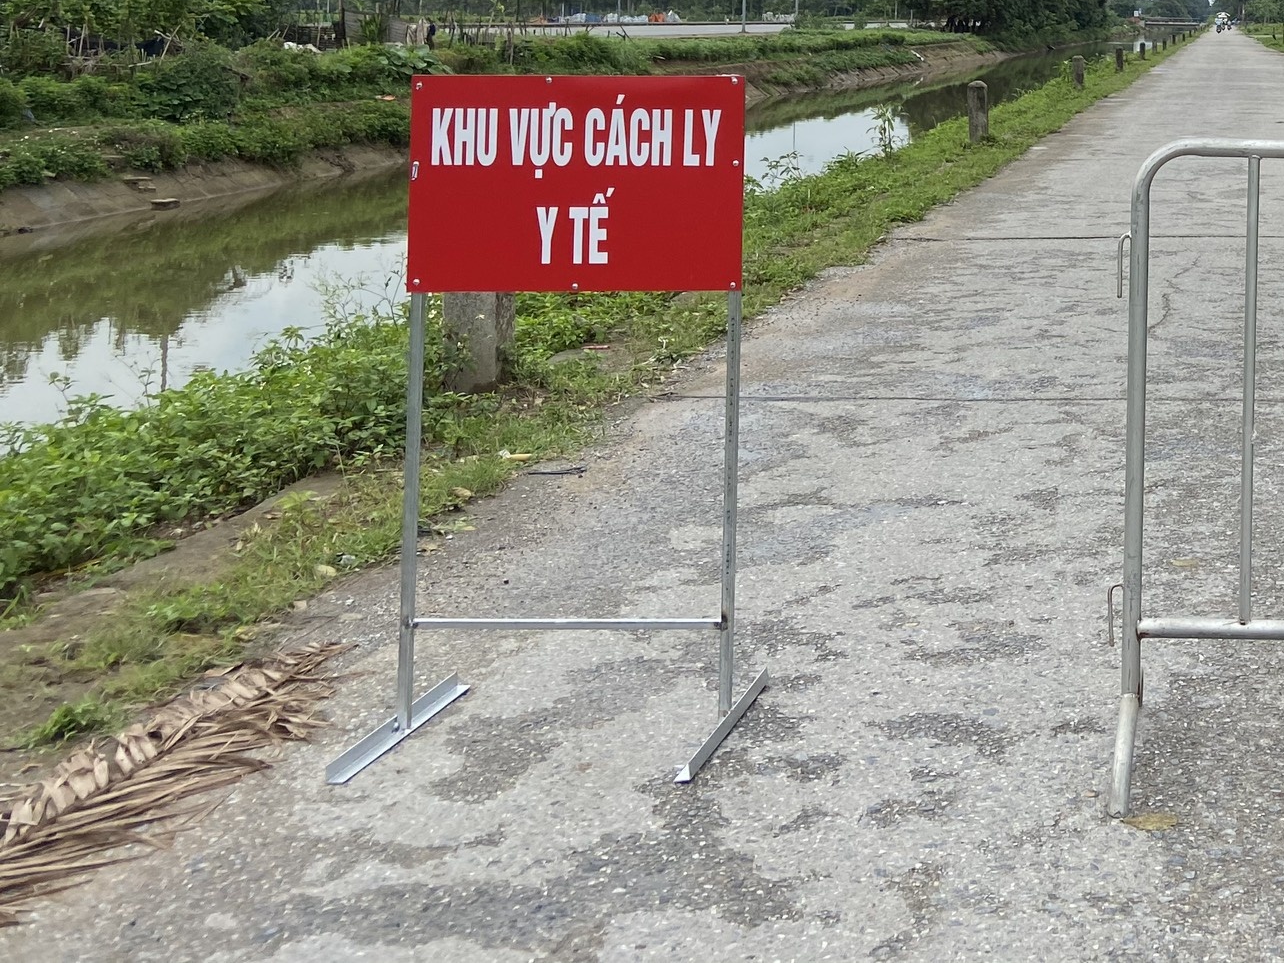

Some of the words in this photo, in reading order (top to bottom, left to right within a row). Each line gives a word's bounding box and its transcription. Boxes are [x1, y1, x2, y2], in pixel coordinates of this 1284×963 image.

[431, 107, 498, 167] KHU
[509, 102, 574, 179] VỰC
[584, 94, 673, 167] CÁCH
[683, 109, 722, 167] LY
[536, 206, 559, 264] Y
[569, 187, 615, 264] TẾ
